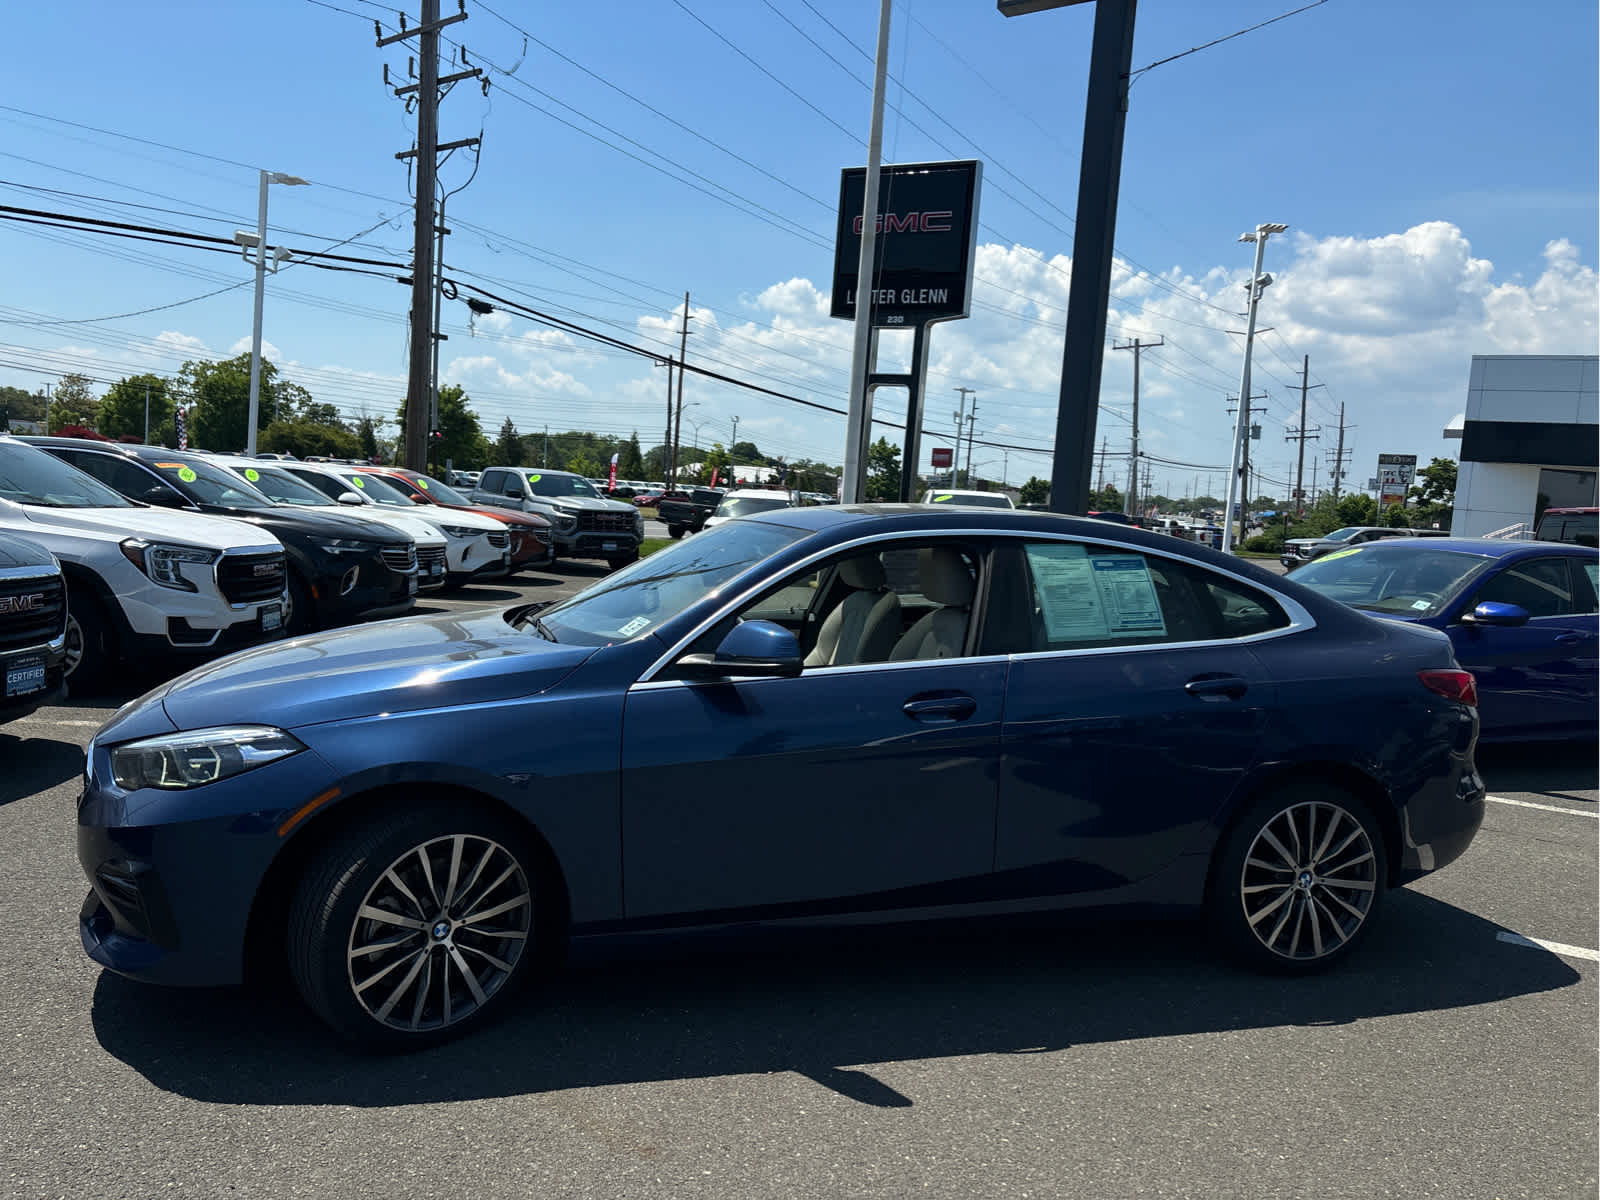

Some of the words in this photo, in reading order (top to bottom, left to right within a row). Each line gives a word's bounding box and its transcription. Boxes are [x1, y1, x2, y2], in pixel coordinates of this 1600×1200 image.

[854, 211, 952, 234] GMC
[847, 290, 896, 304] LTER
[901, 288, 948, 304] GLENN
[7, 668, 45, 683] CERTIFIED
